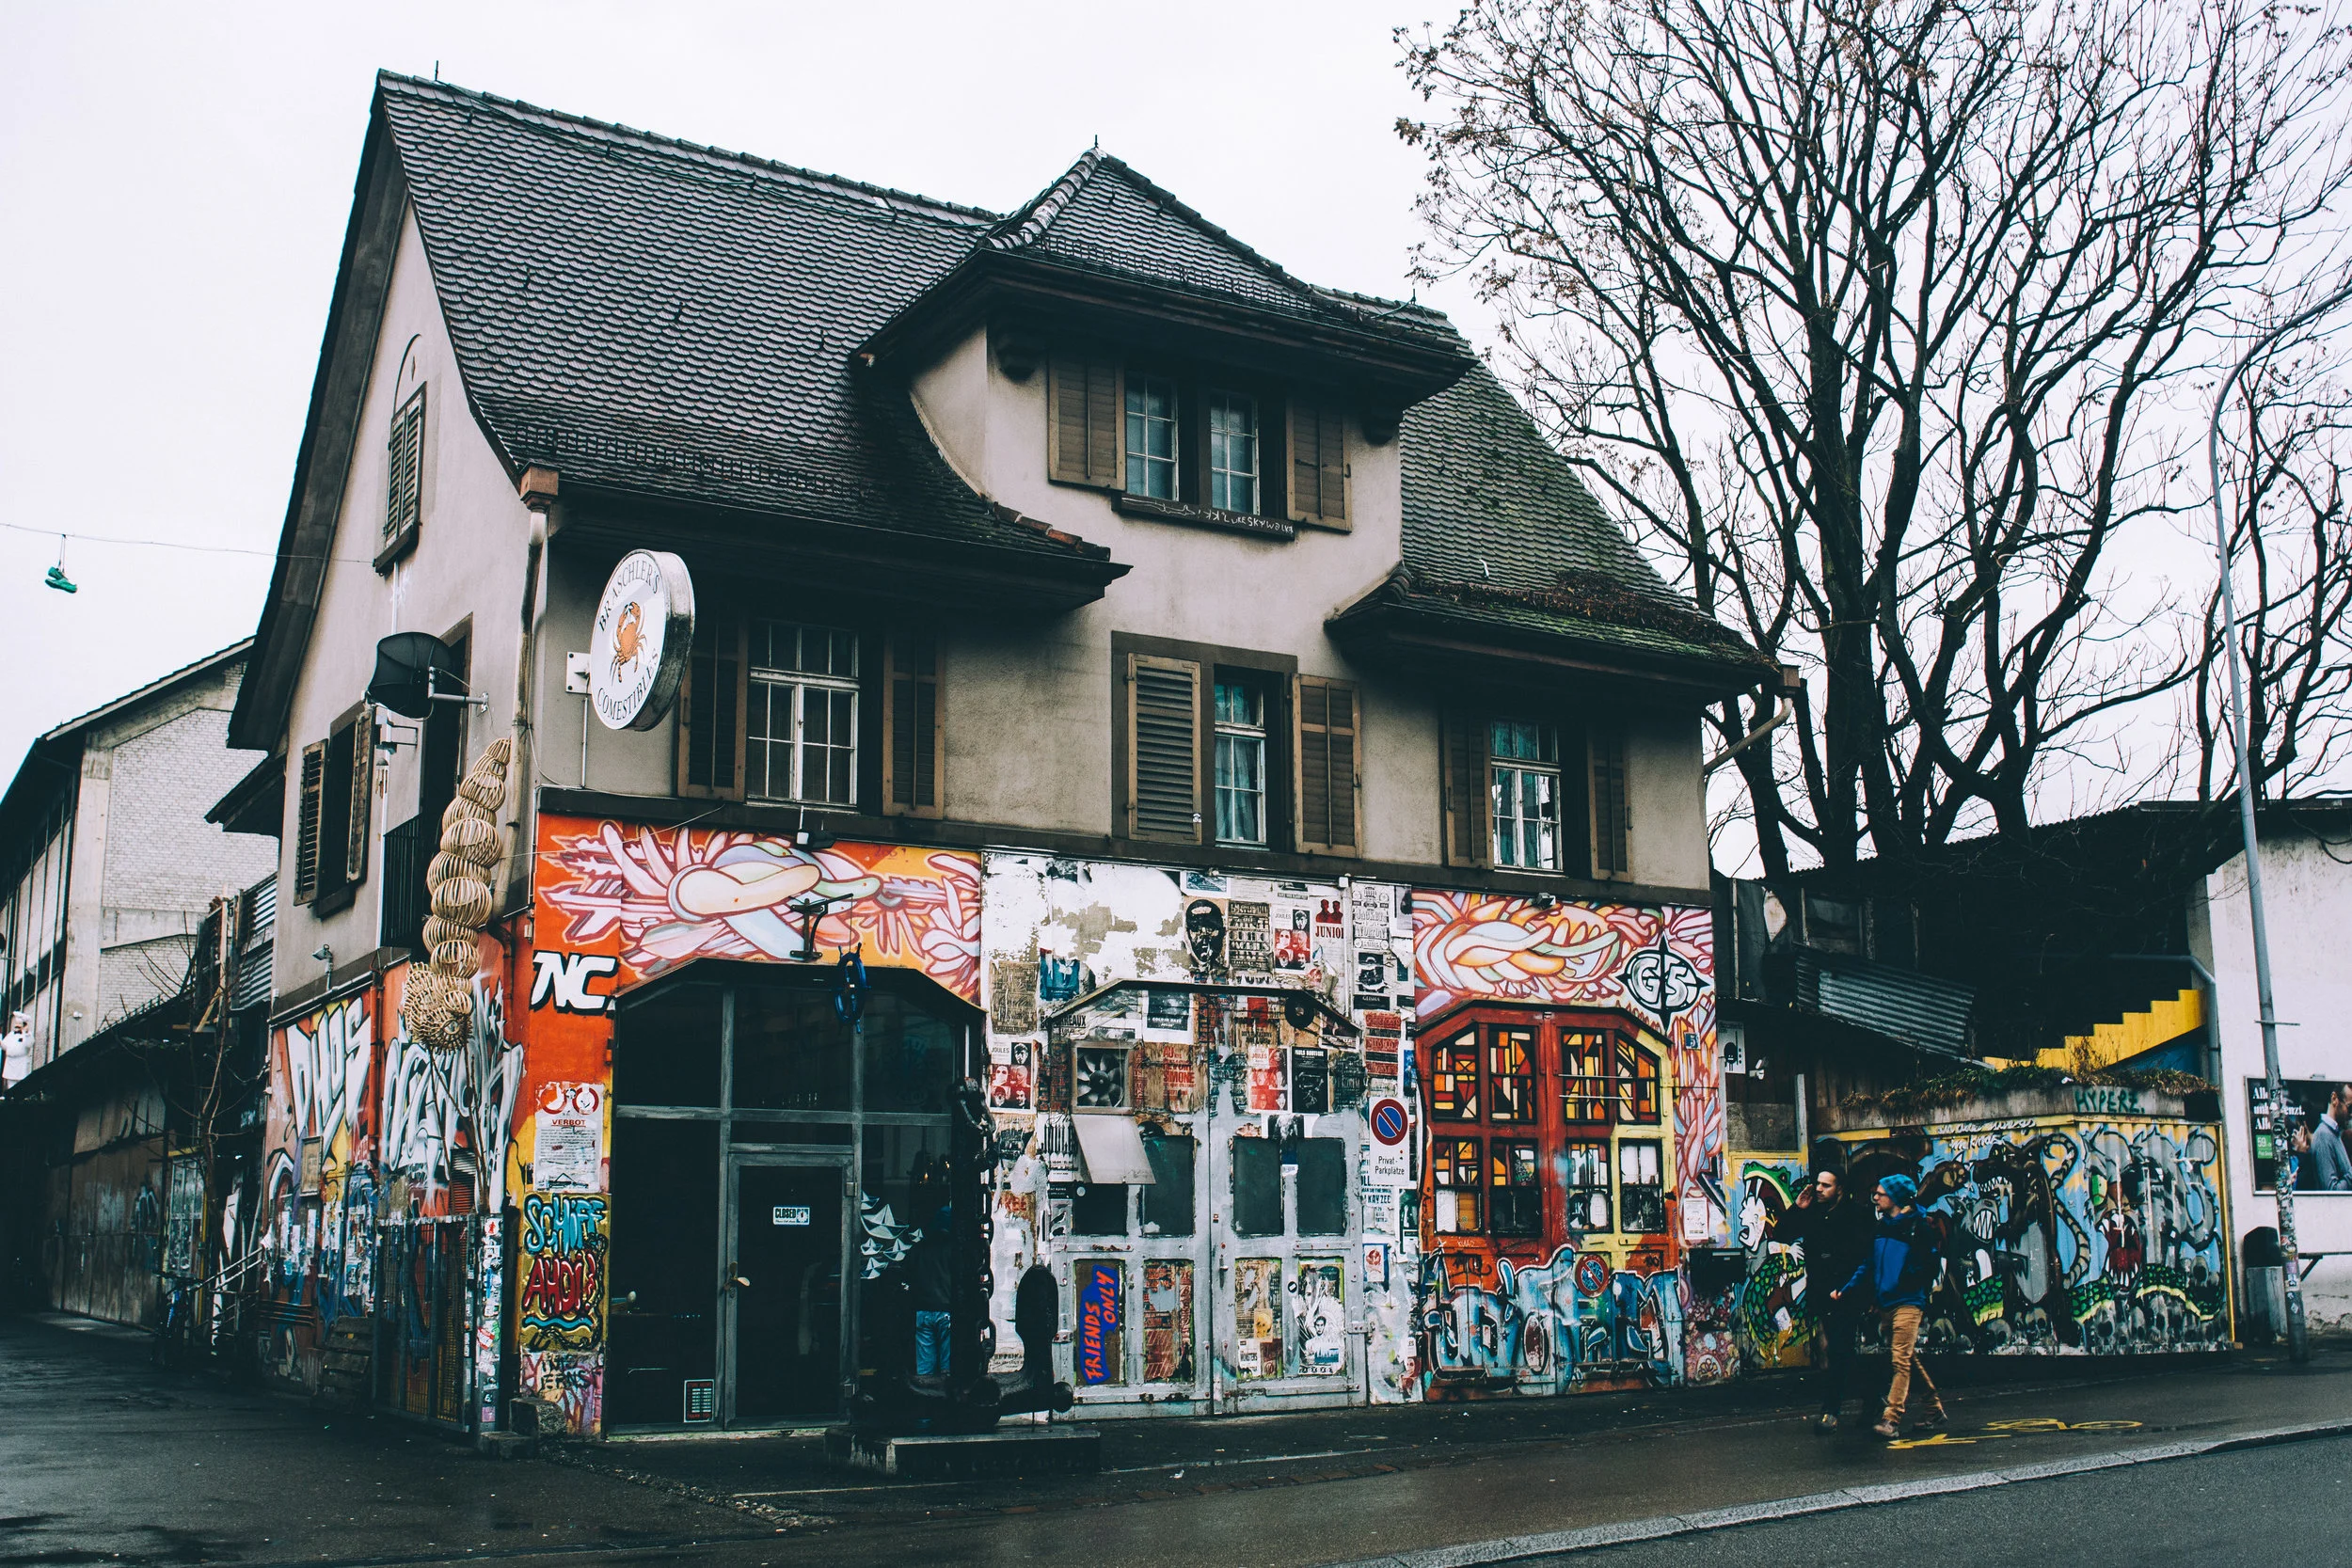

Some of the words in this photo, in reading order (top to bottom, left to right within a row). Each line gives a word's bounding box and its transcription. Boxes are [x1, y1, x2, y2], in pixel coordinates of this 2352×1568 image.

[598, 560, 660, 632] BRASCHLER'S
[596, 648, 660, 721] COMESTIBLES
[1163, 1071, 1195, 1084] SIMONE
[775, 1208, 797, 1218] CLOSED
[1096, 1270, 1117, 1324] ONLY
[1084, 1302, 1104, 1381] FRIENDS
